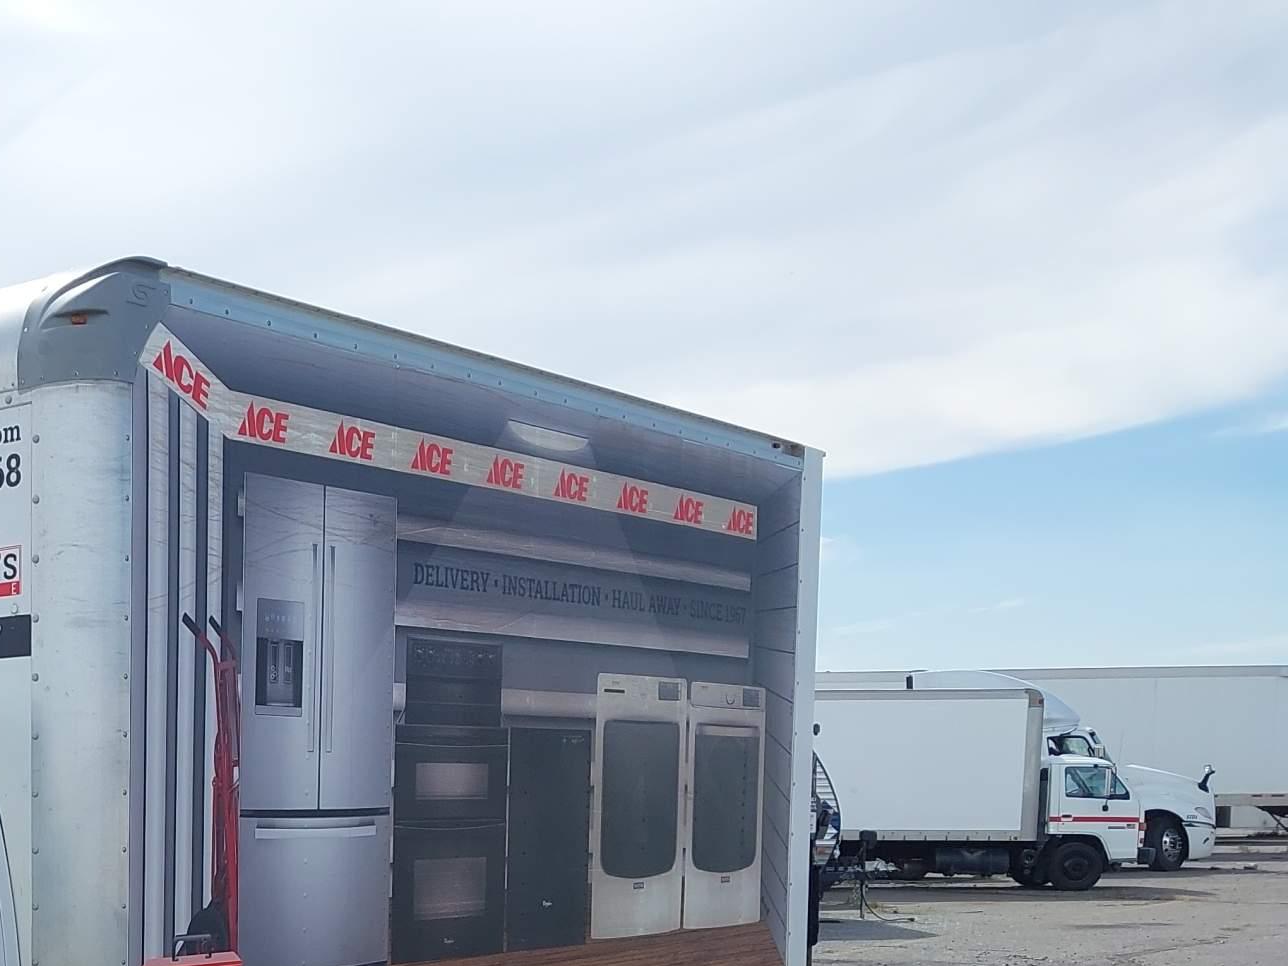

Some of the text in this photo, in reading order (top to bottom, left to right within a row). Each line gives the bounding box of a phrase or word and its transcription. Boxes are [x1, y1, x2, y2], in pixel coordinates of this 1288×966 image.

[152, 340, 210, 411] ACE
[237, 400, 289, 443] ACE
[329, 419, 375, 460] ACE
[411, 437, 453, 475] ACE
[486, 454, 525, 489] ACE
[554, 468, 589, 501] ACE
[616, 481, 648, 513] ACE
[673, 494, 703, 524] ACE
[726, 505, 753, 535] ACE
[413, 562, 747, 624] DELIVERY INSTALLATION HAUL AWAY SINCE 1967
